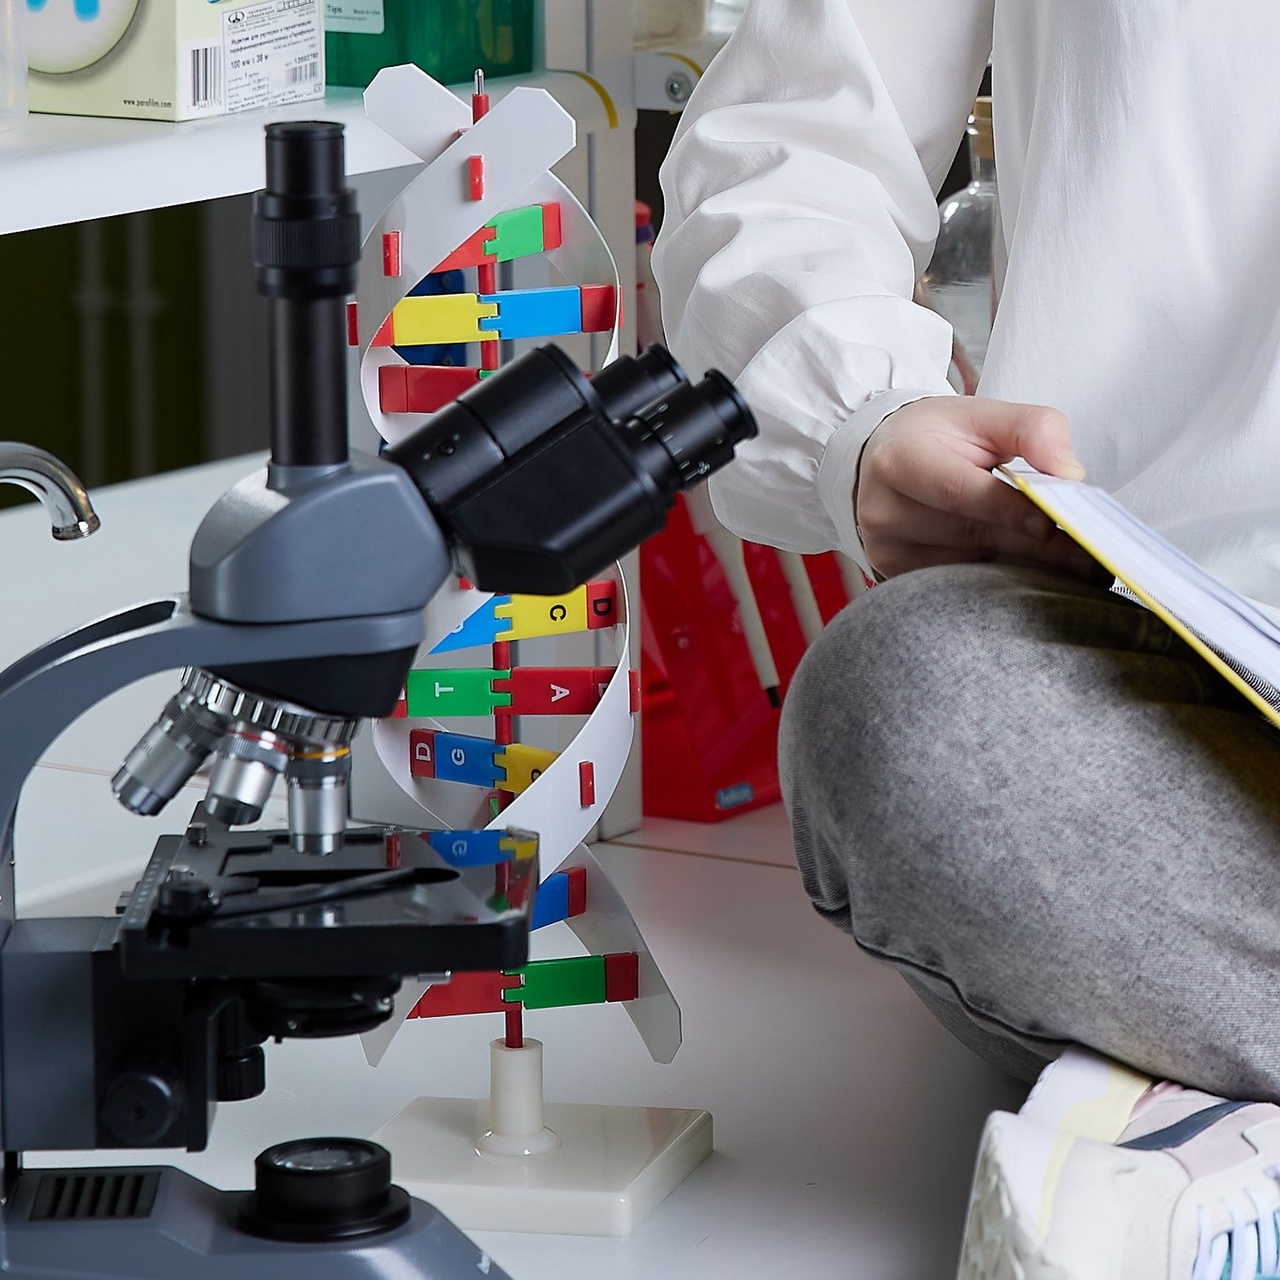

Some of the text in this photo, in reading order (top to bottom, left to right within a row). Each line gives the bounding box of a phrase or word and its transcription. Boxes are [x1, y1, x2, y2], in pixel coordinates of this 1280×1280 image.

[550, 604, 566, 621] C
[593, 598, 612, 616] D
[435, 682, 454, 698] T
[550, 683, 570, 702] A
[416, 742, 432, 762] D
[451, 748, 465, 766] G
